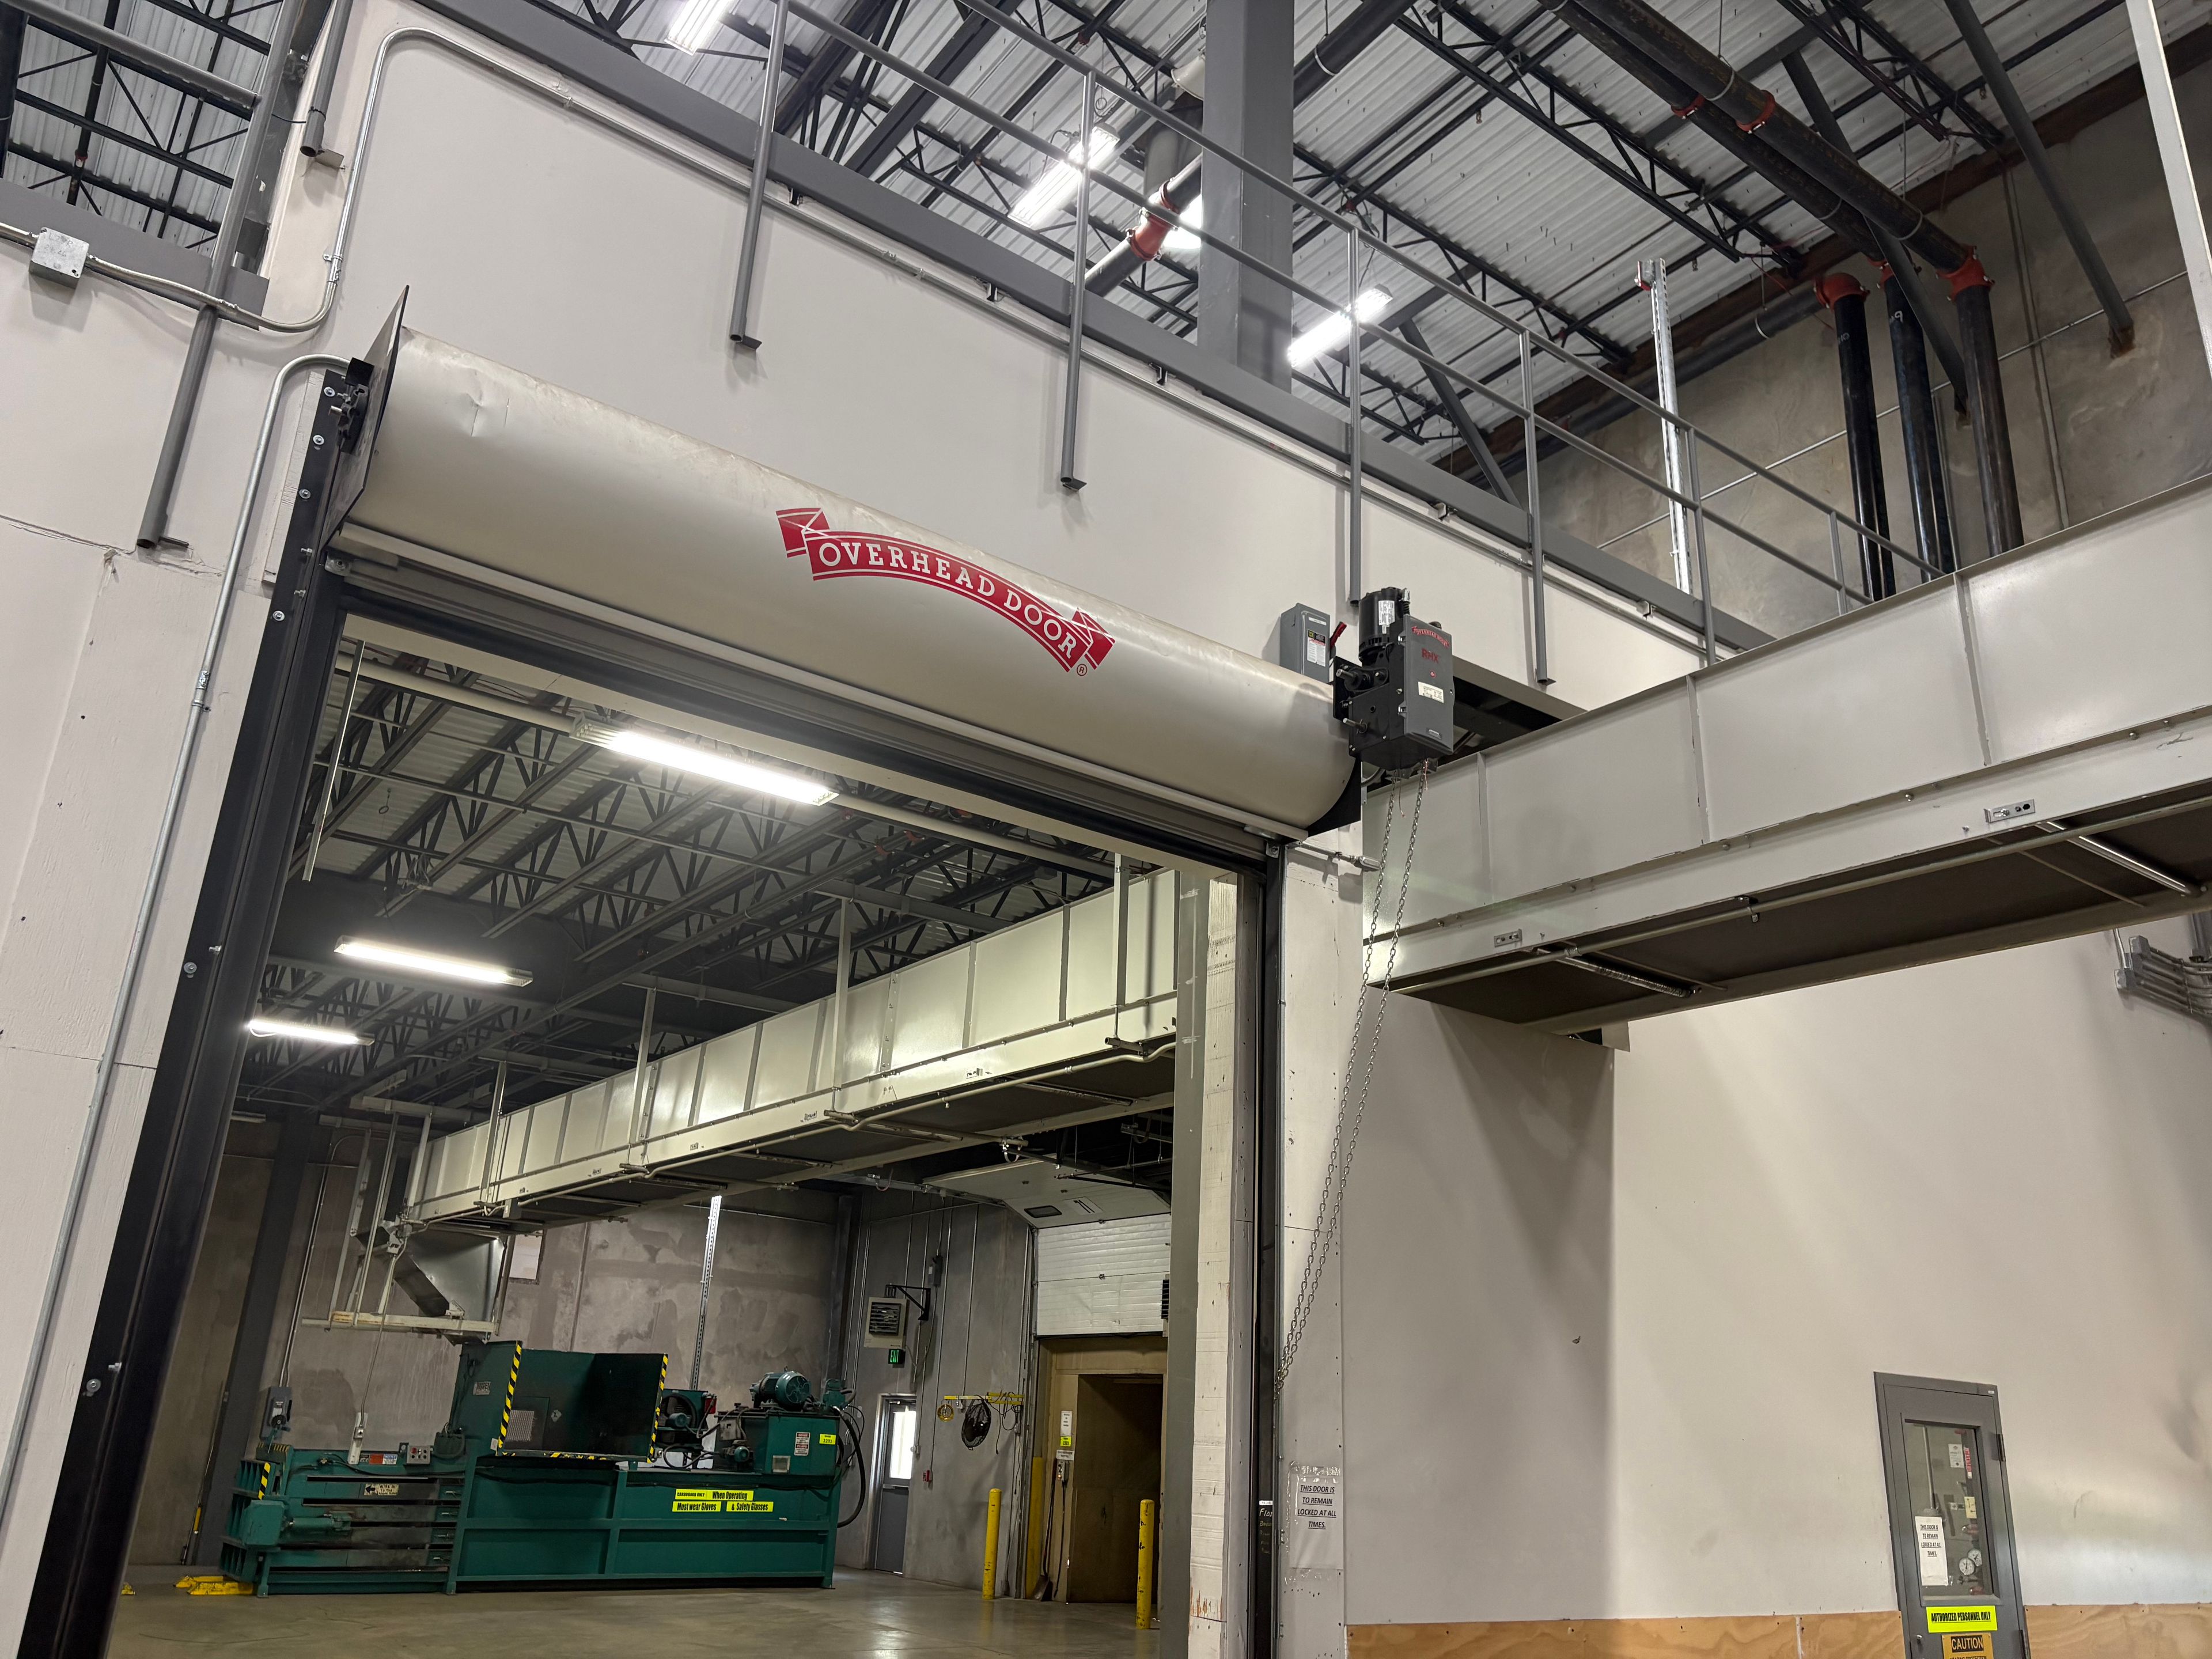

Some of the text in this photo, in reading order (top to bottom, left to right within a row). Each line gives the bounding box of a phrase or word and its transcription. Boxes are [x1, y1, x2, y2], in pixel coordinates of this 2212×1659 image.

[819, 542, 1077, 659] OVERHEAD DOOR
[890, 1350, 899, 1363] EXIT
[712, 1491, 748, 1501] When Operating
[677, 1502, 688, 1510] Must
[736, 1502, 750, 1512] Safety
[1931, 1611, 1991, 1622] AUTHORIZED PERSONNEL ONLY
[1951, 1637, 1983, 1651] CAUTION
